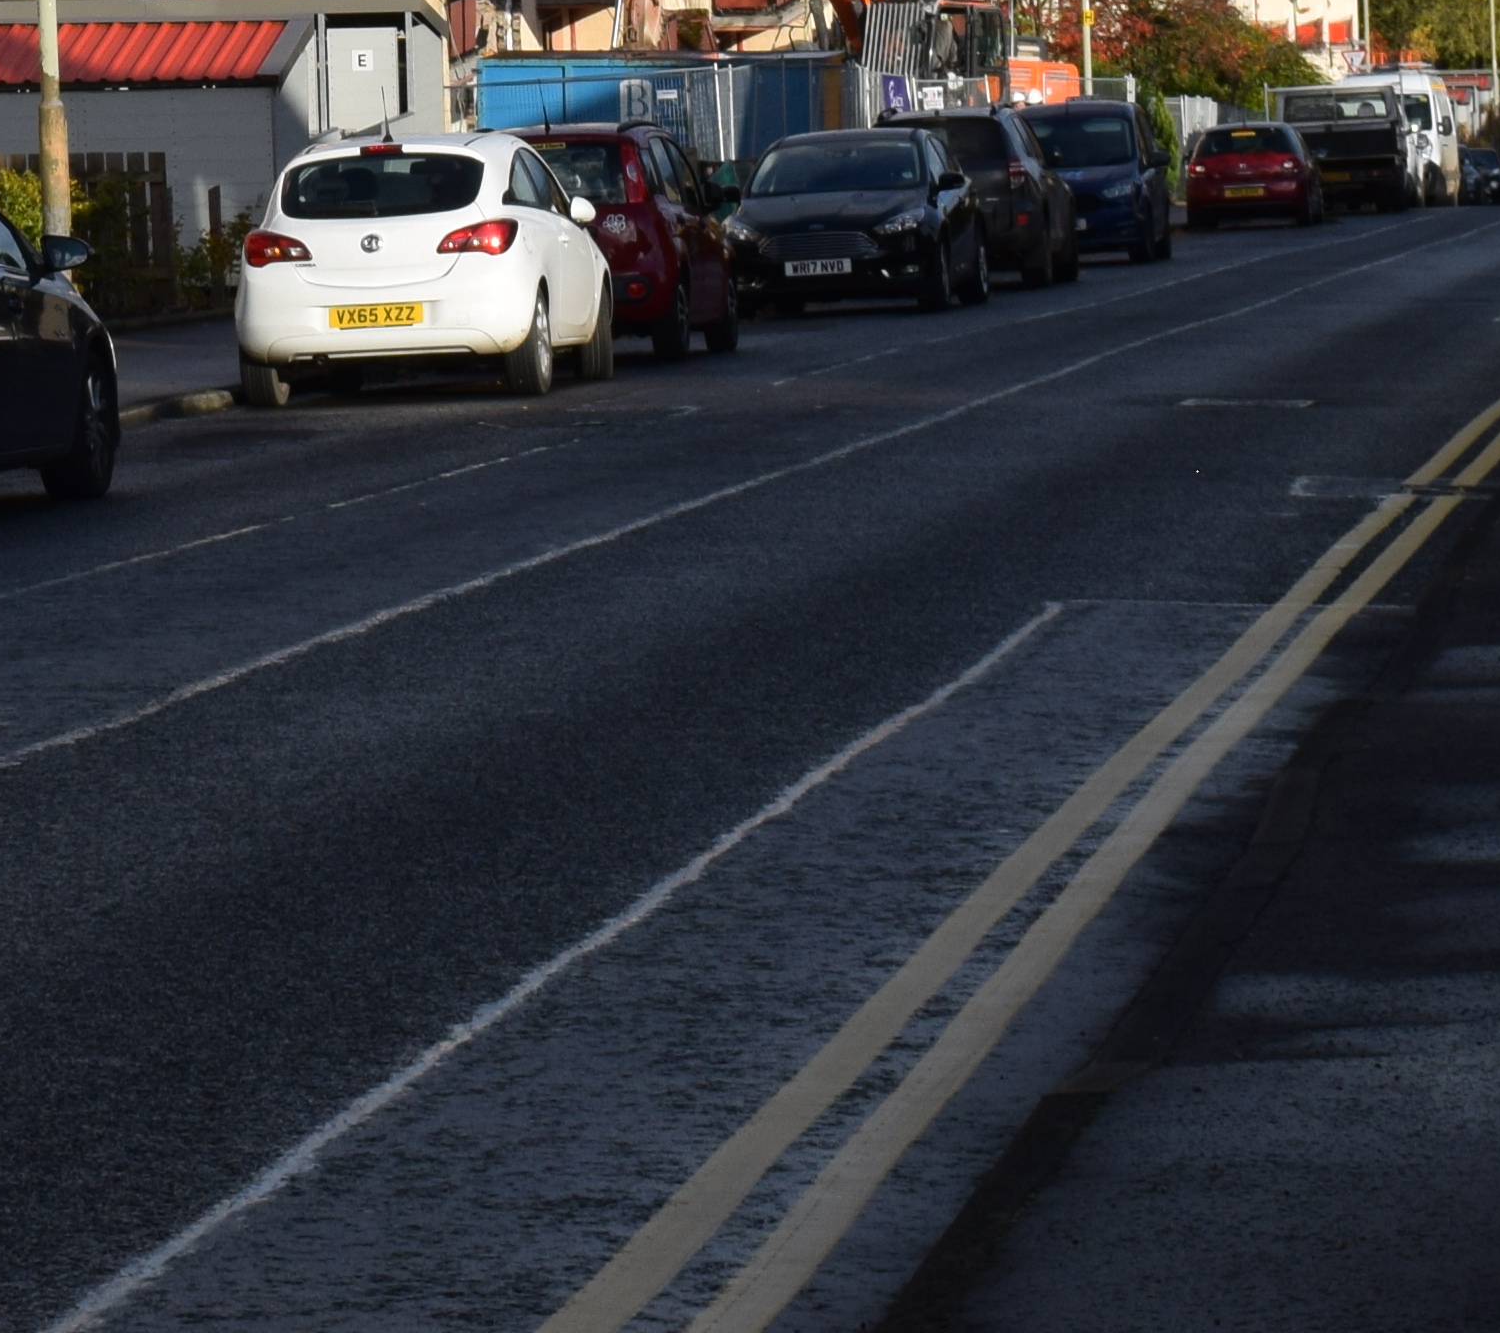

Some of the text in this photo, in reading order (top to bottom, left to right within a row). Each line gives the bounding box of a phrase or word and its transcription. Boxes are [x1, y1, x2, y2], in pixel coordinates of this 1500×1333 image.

[358, 54, 367, 67] E
[626, 85, 649, 119] B
[336, 306, 415, 324] VX65 XZZ
